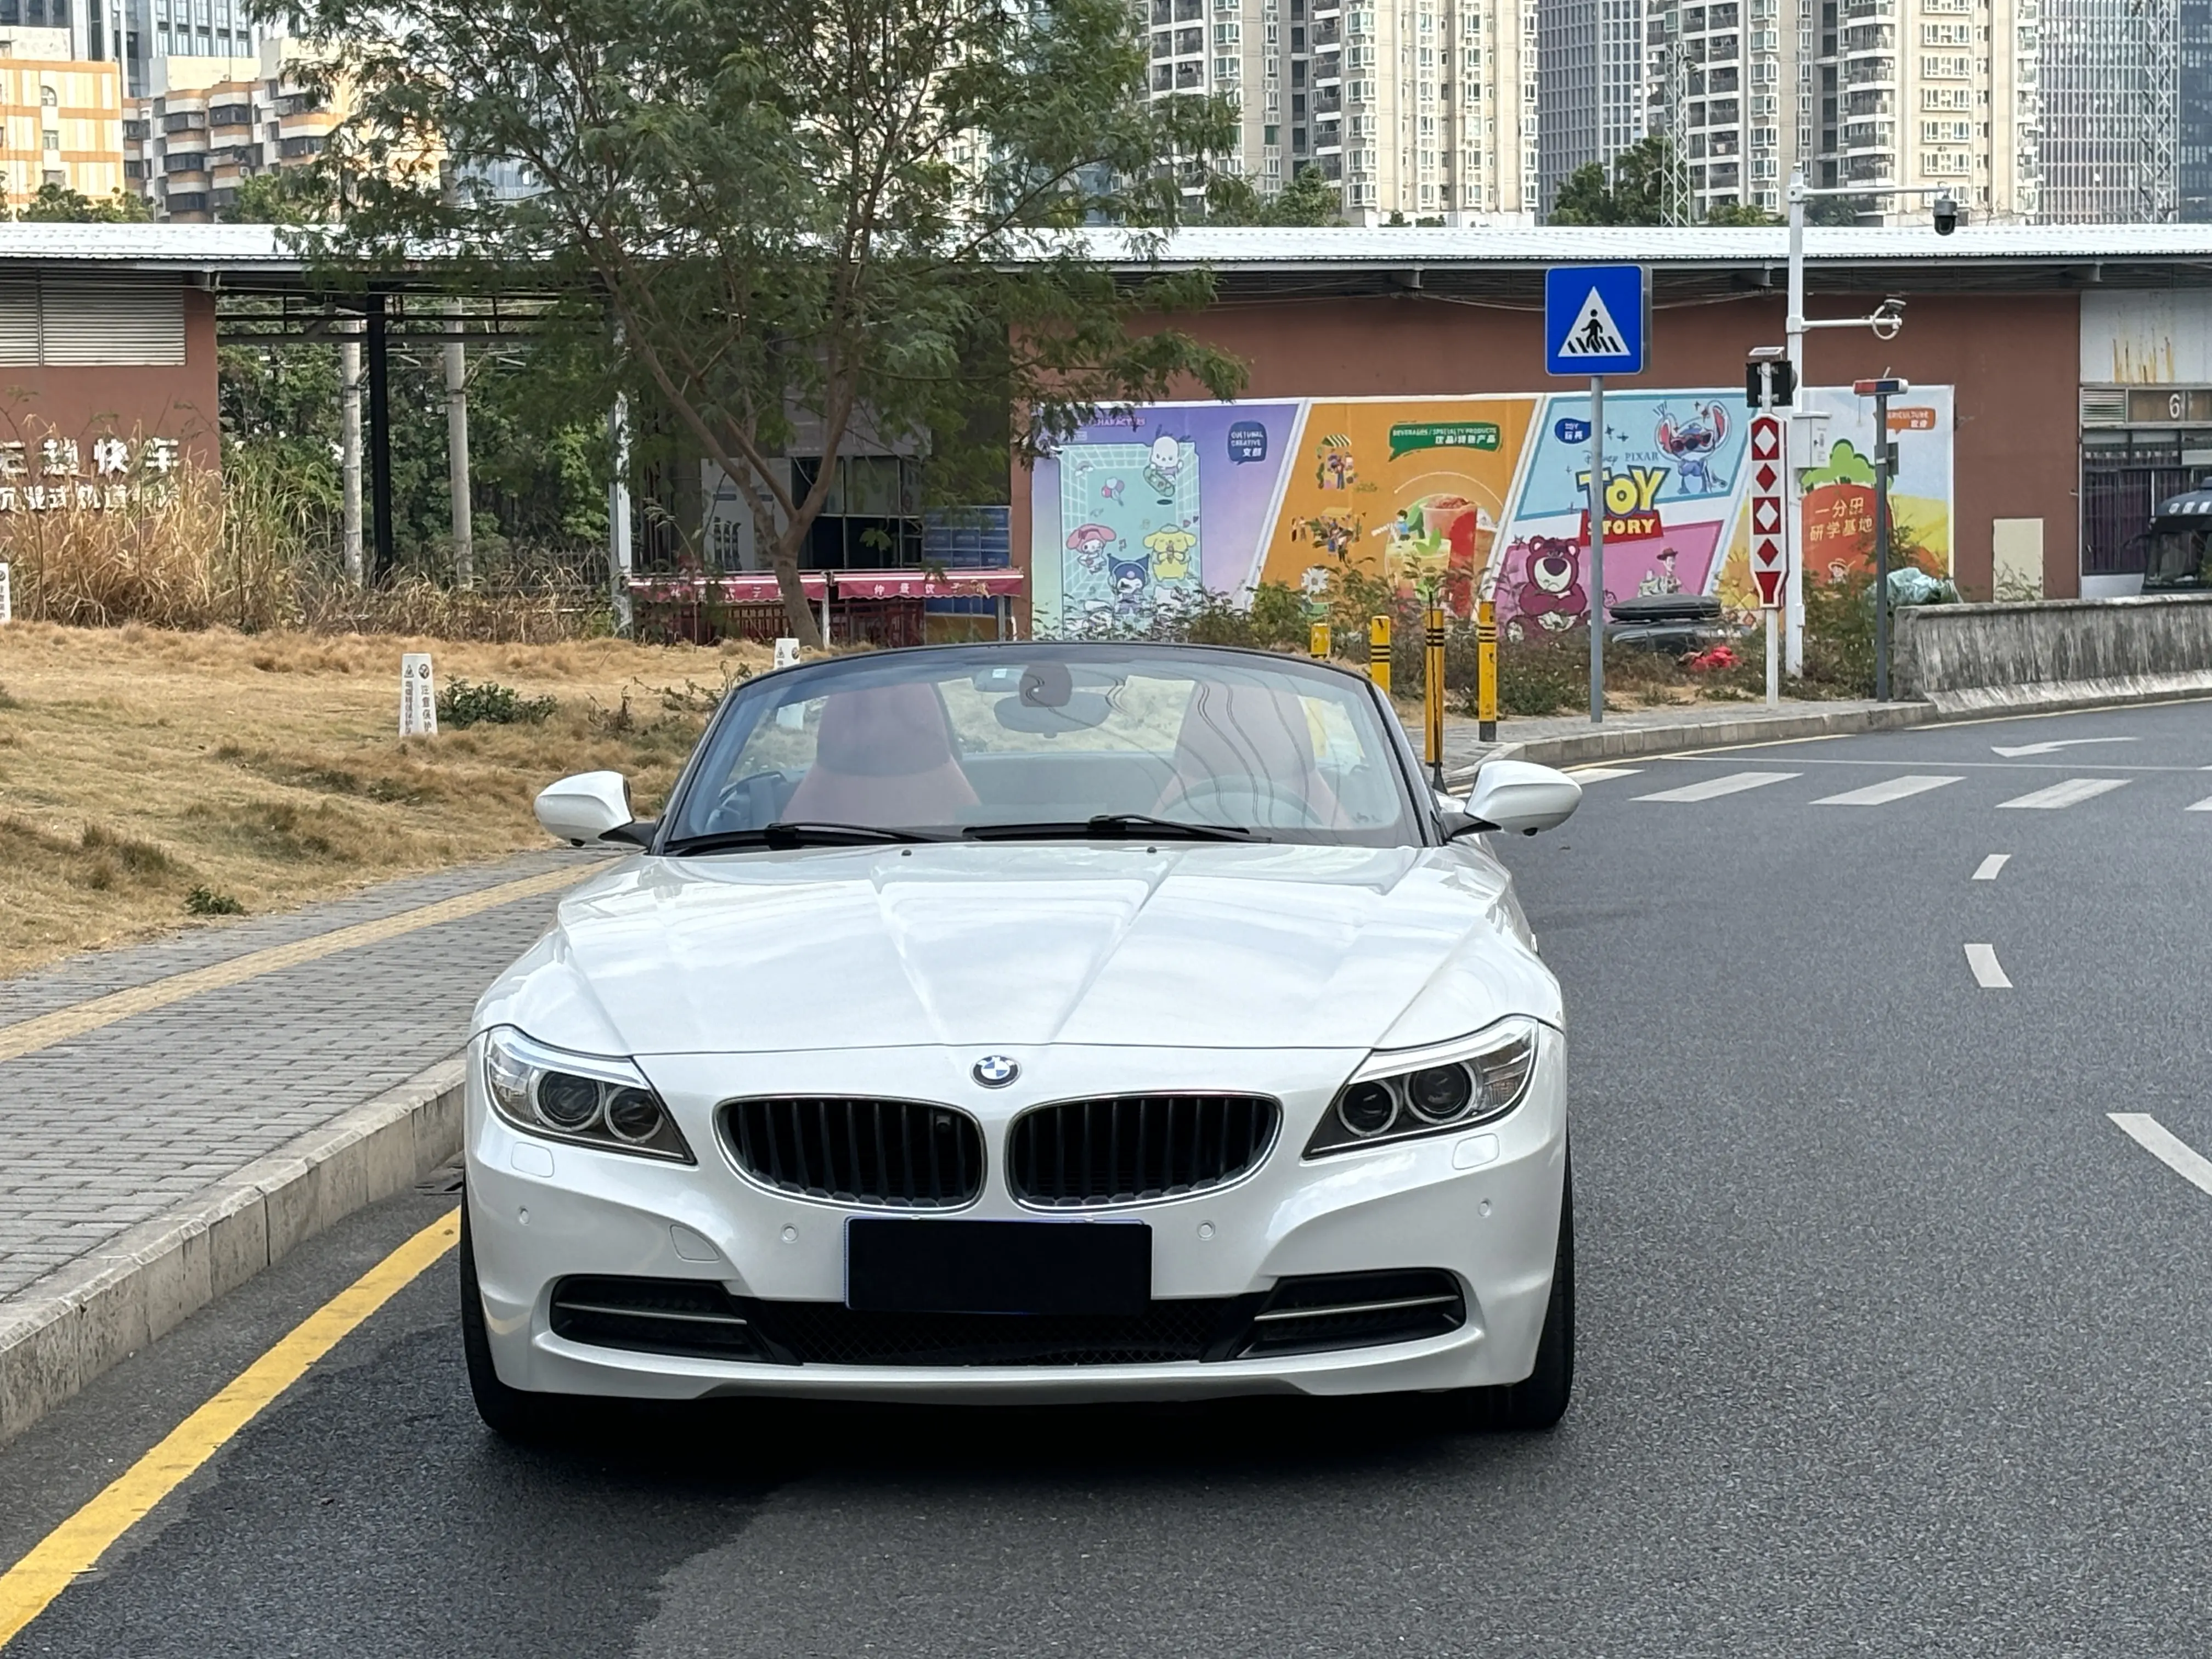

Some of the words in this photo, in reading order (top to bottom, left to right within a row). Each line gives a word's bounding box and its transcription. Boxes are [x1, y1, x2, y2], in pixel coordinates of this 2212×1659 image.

[1887, 410, 1929, 419] GRICULTURE
[1625, 452, 1659, 461] PIXAR
[1576, 465, 1671, 517] TOY
[1815, 497, 1864, 518] 一分田
[1810, 515, 1872, 541] 研学基地
